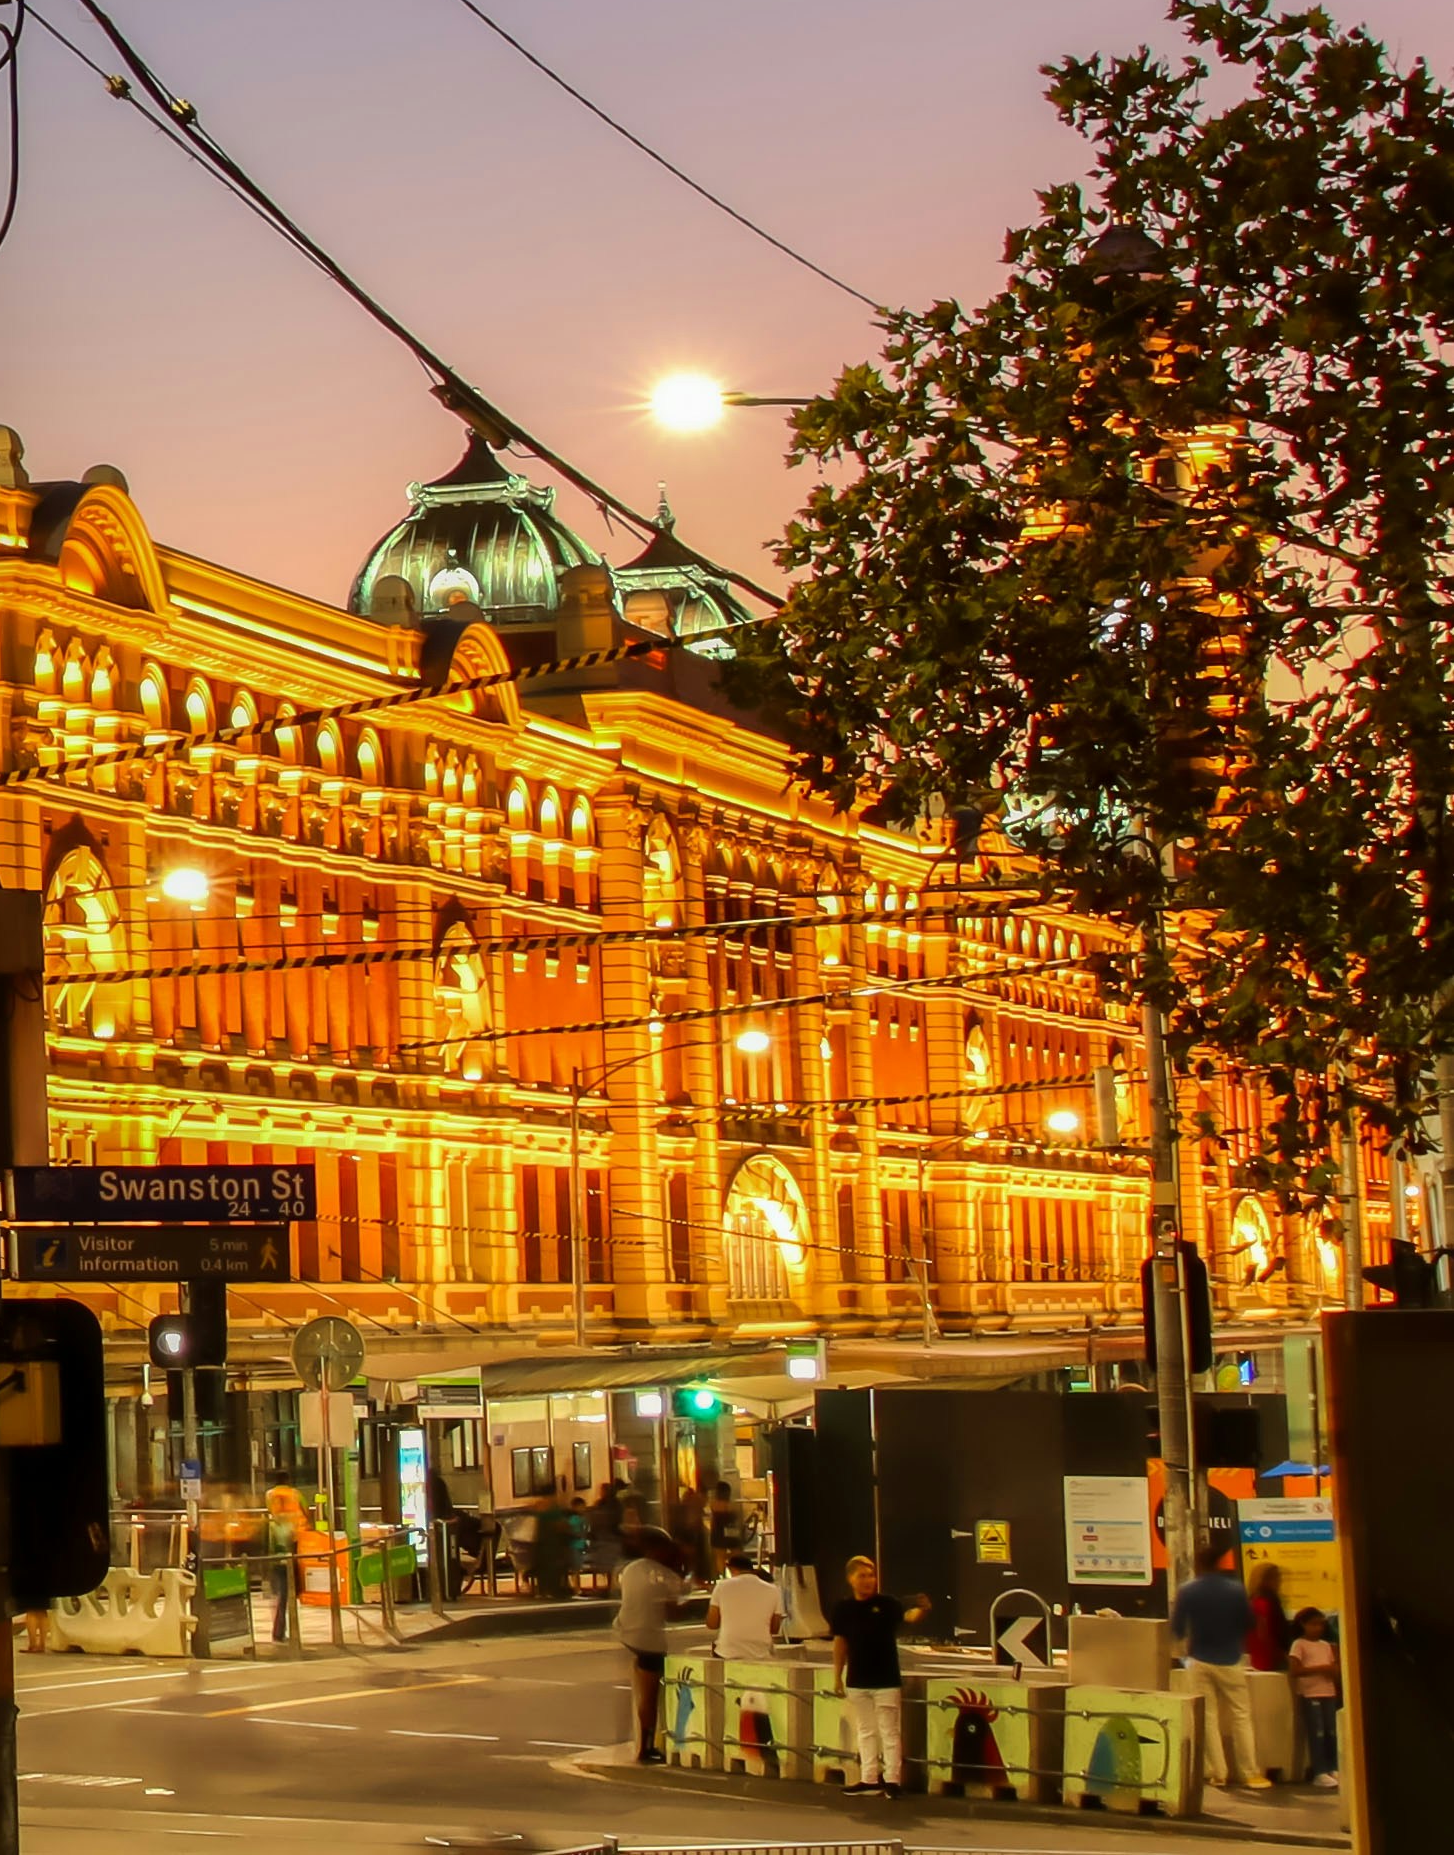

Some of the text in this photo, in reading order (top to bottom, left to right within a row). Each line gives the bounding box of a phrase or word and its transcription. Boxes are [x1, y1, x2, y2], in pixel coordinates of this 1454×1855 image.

[98, 1169, 306, 1202] Swanston St
[228, 1201, 251, 1217] 24
[278, 1201, 305, 1217] 40
[79, 1235, 135, 1252] Visitor
[209, 1238, 248, 1251] 5 min
[79, 1256, 180, 1273] information
[200, 1258, 249, 1272] 0.4 km
